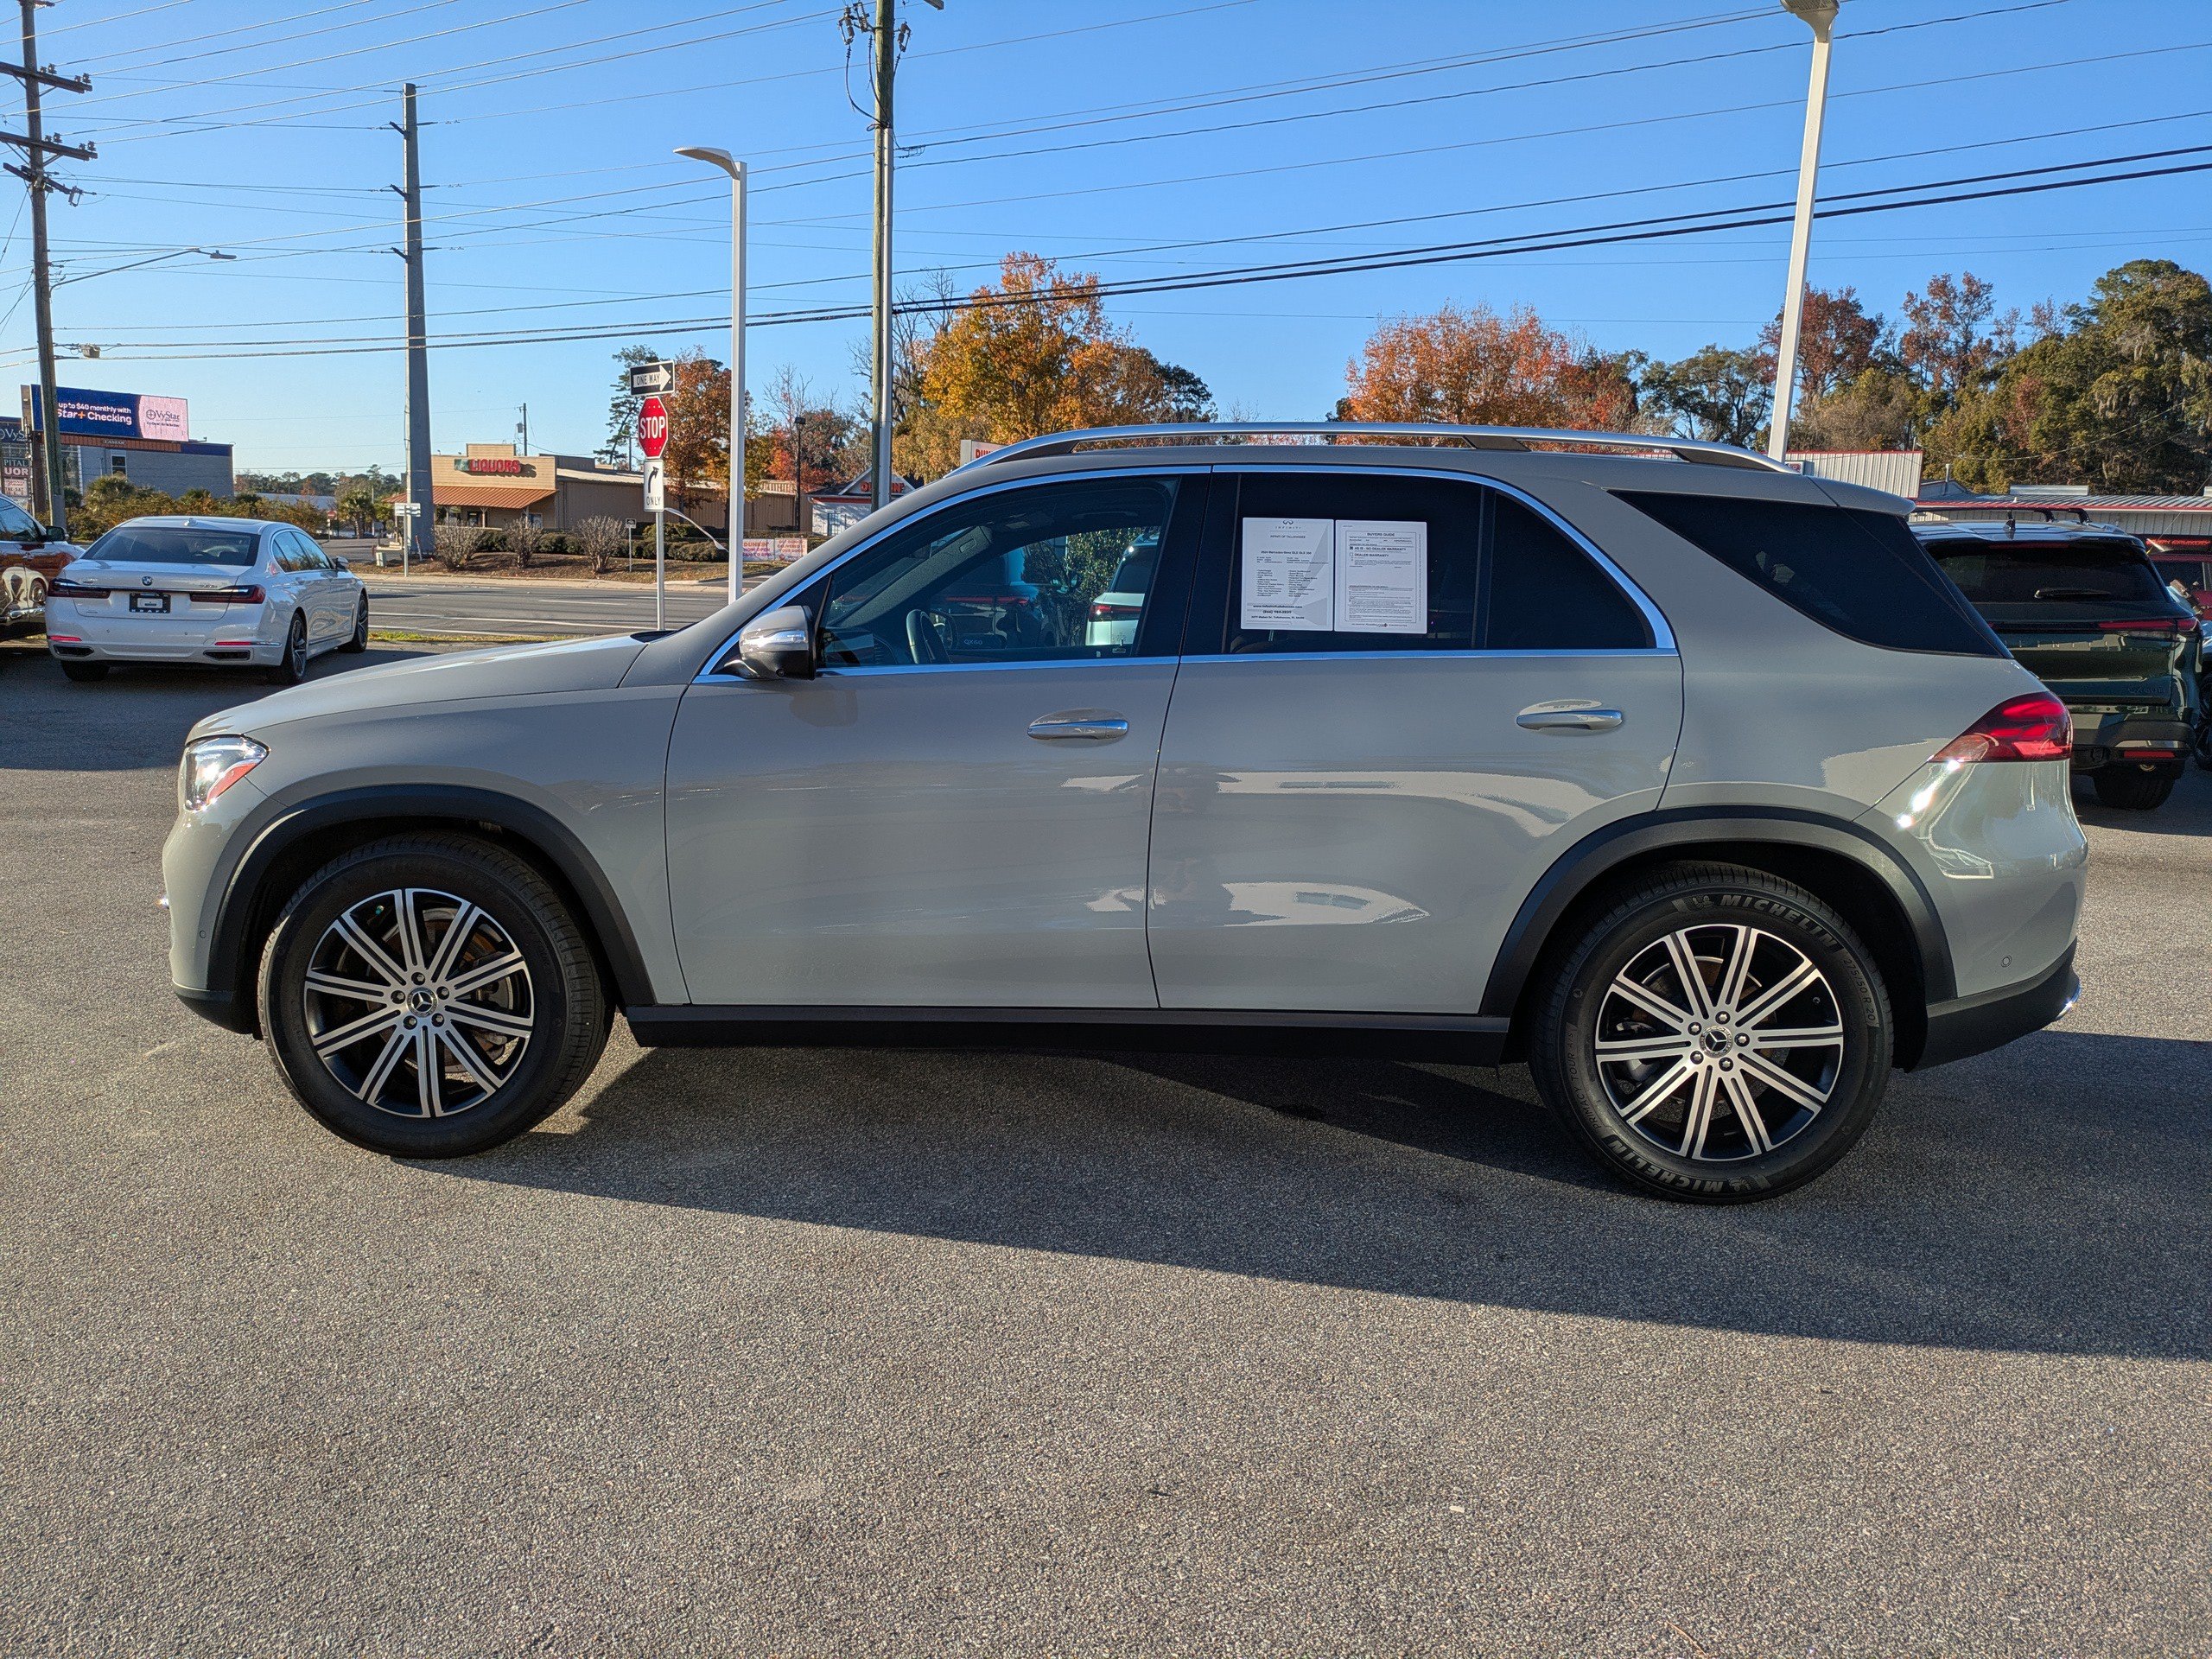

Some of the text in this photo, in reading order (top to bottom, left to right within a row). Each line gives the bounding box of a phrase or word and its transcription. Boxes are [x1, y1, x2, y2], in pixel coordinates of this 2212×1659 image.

[636, 373, 661, 385] ONE WAY
[76, 402, 89, 410] $40
[90, 405, 118, 414] monthly
[156, 410, 180, 421] VyStar
[87, 411, 132, 425] Checking
[639, 416, 665, 440] STOP
[470, 459, 521, 473] LIQUORS
[645, 496, 661, 506] ONLY
[1719, 893, 1842, 952] MICHELIN
[1844, 958, 1868, 994] 275/50
[1569, 1052, 1579, 1082] TOUR
[1573, 1086, 1602, 1129] PRIMACY
[1607, 1137, 1723, 1193] MICHELIN
